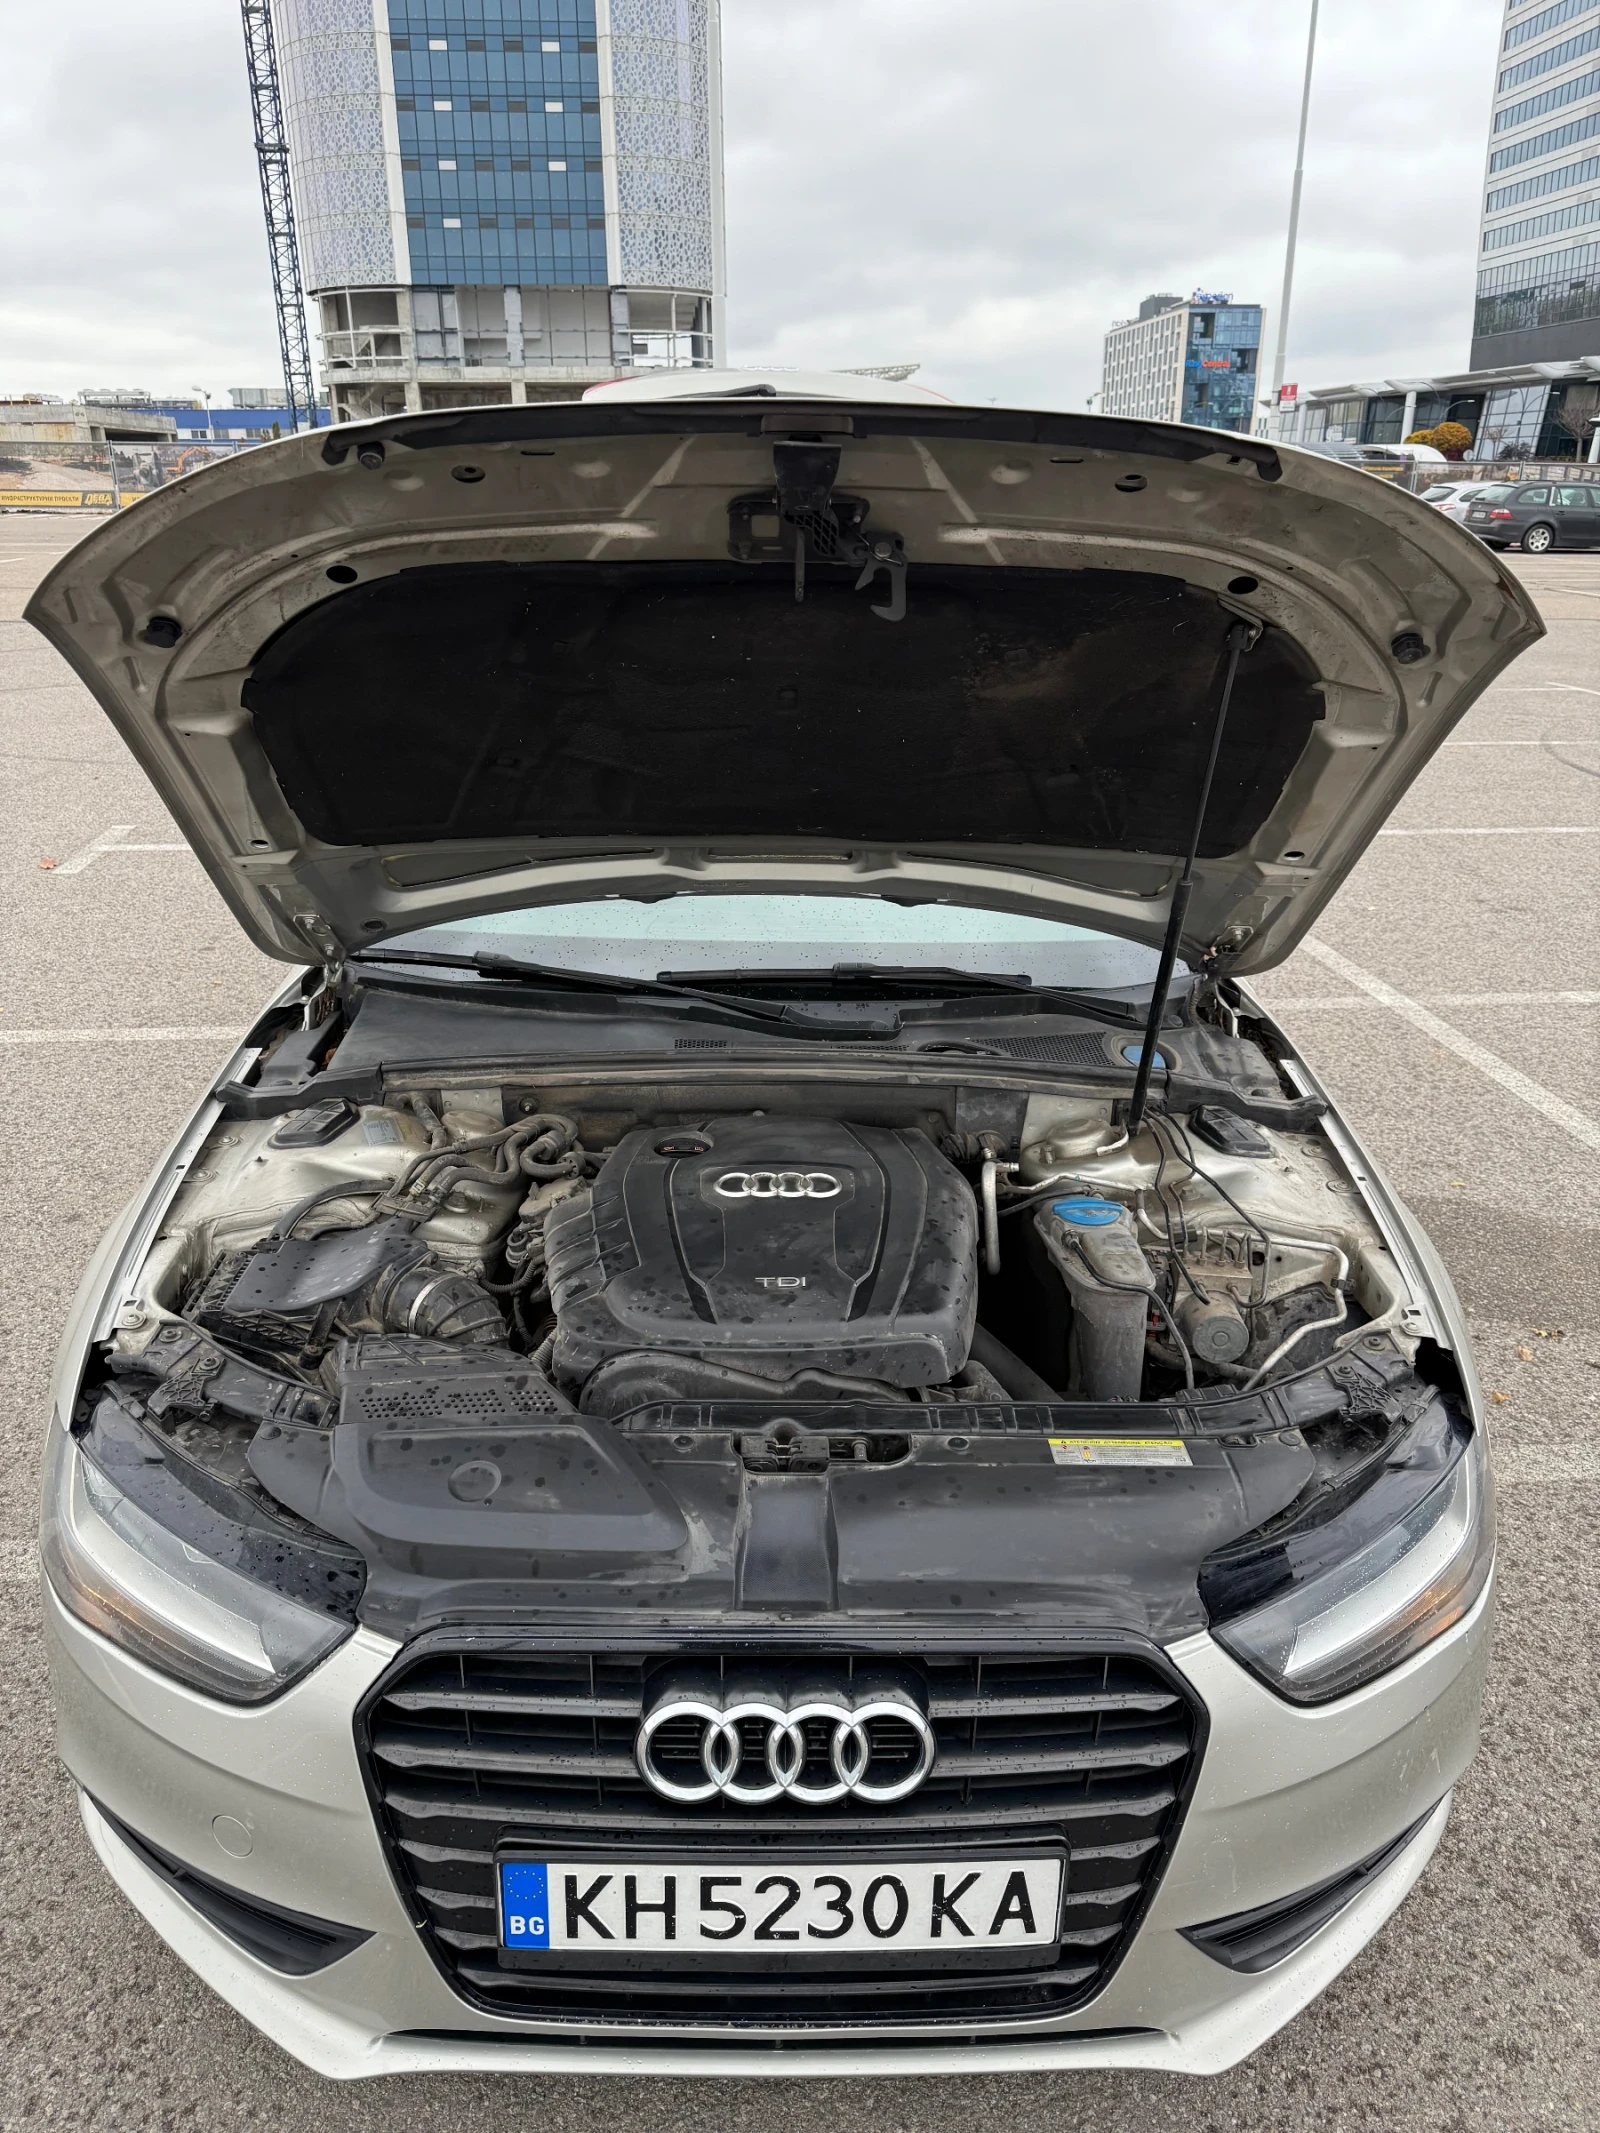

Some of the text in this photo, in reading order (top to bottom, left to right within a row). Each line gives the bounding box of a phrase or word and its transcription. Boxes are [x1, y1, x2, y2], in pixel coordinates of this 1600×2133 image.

[755, 1276, 806, 1288] TDI
[699, 1874, 909, 1941] 5230
[509, 1915, 546, 1936] BG
